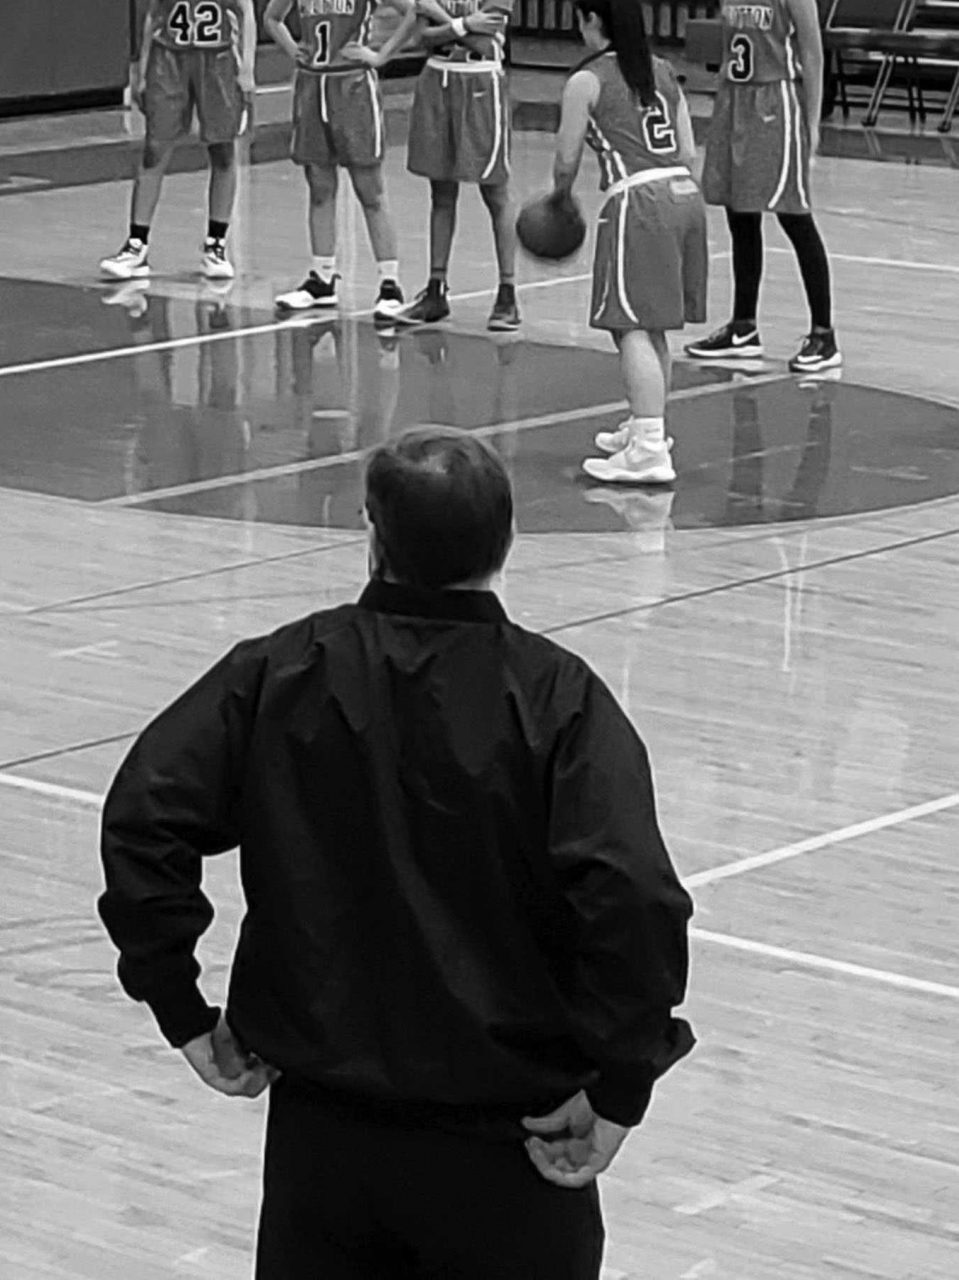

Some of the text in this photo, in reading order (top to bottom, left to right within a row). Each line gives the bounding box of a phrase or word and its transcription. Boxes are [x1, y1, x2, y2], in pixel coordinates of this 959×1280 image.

[167, 1, 221, 47] 42
[313, 21, 330, 65] 1
[728, 33, 754, 82] 3
[641, 89, 677, 154] 2
